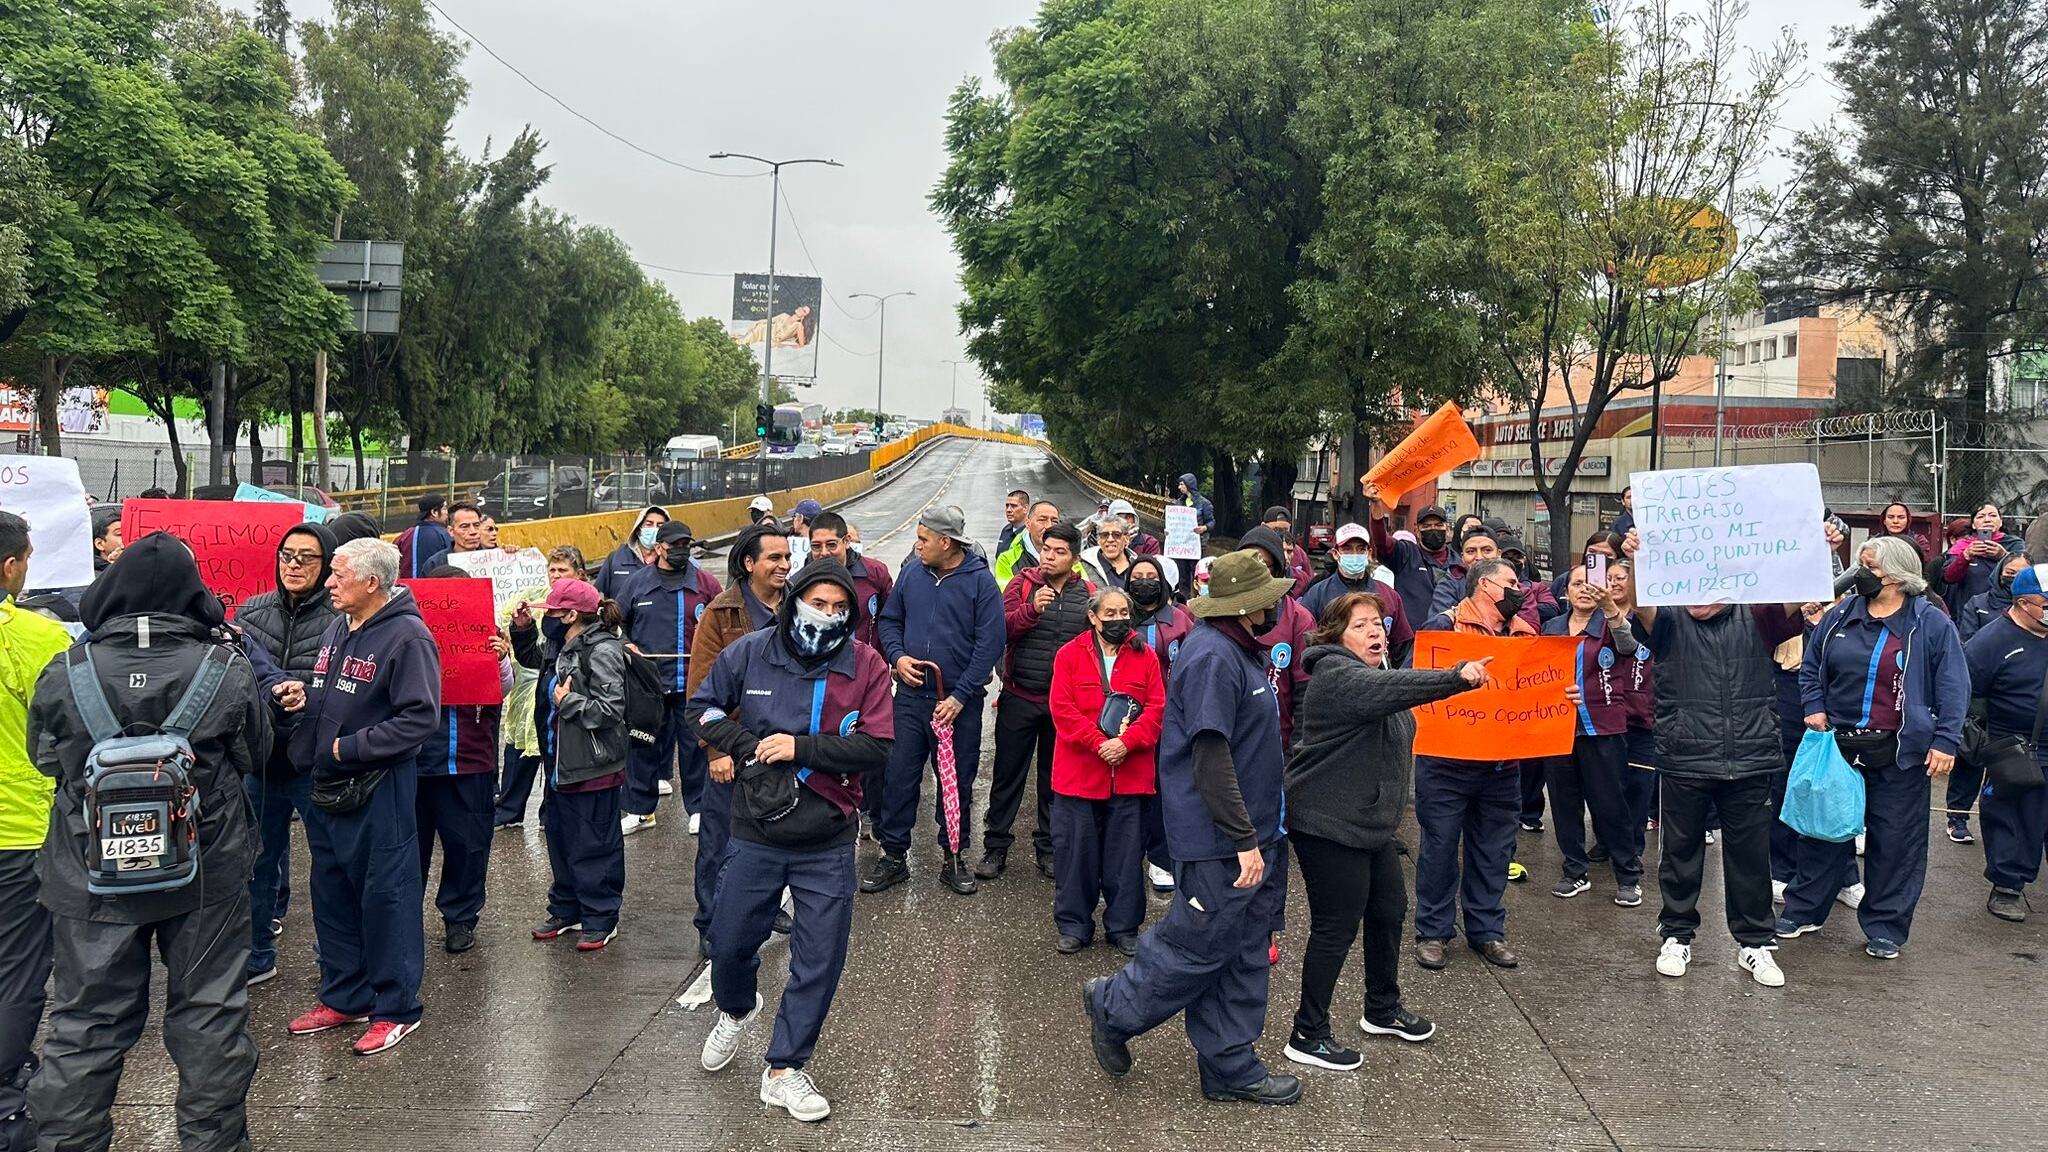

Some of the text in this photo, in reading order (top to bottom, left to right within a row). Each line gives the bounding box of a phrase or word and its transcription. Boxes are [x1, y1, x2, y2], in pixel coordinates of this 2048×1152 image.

[1494, 423, 1514, 443] AUTO
[1641, 472, 1737, 502] EXIJES
[1639, 502, 1744, 524] TRABAJO
[1646, 520, 1763, 546] EXIJO MI
[1647, 538, 1801, 571] PAGO PUNTUAL
[492, 564, 514, 576] nos
[1505, 664, 1566, 692] derecho
[1445, 704, 1486, 726] pago
[125, 813, 153, 821] 61835
[105, 836, 162, 856] 61835
